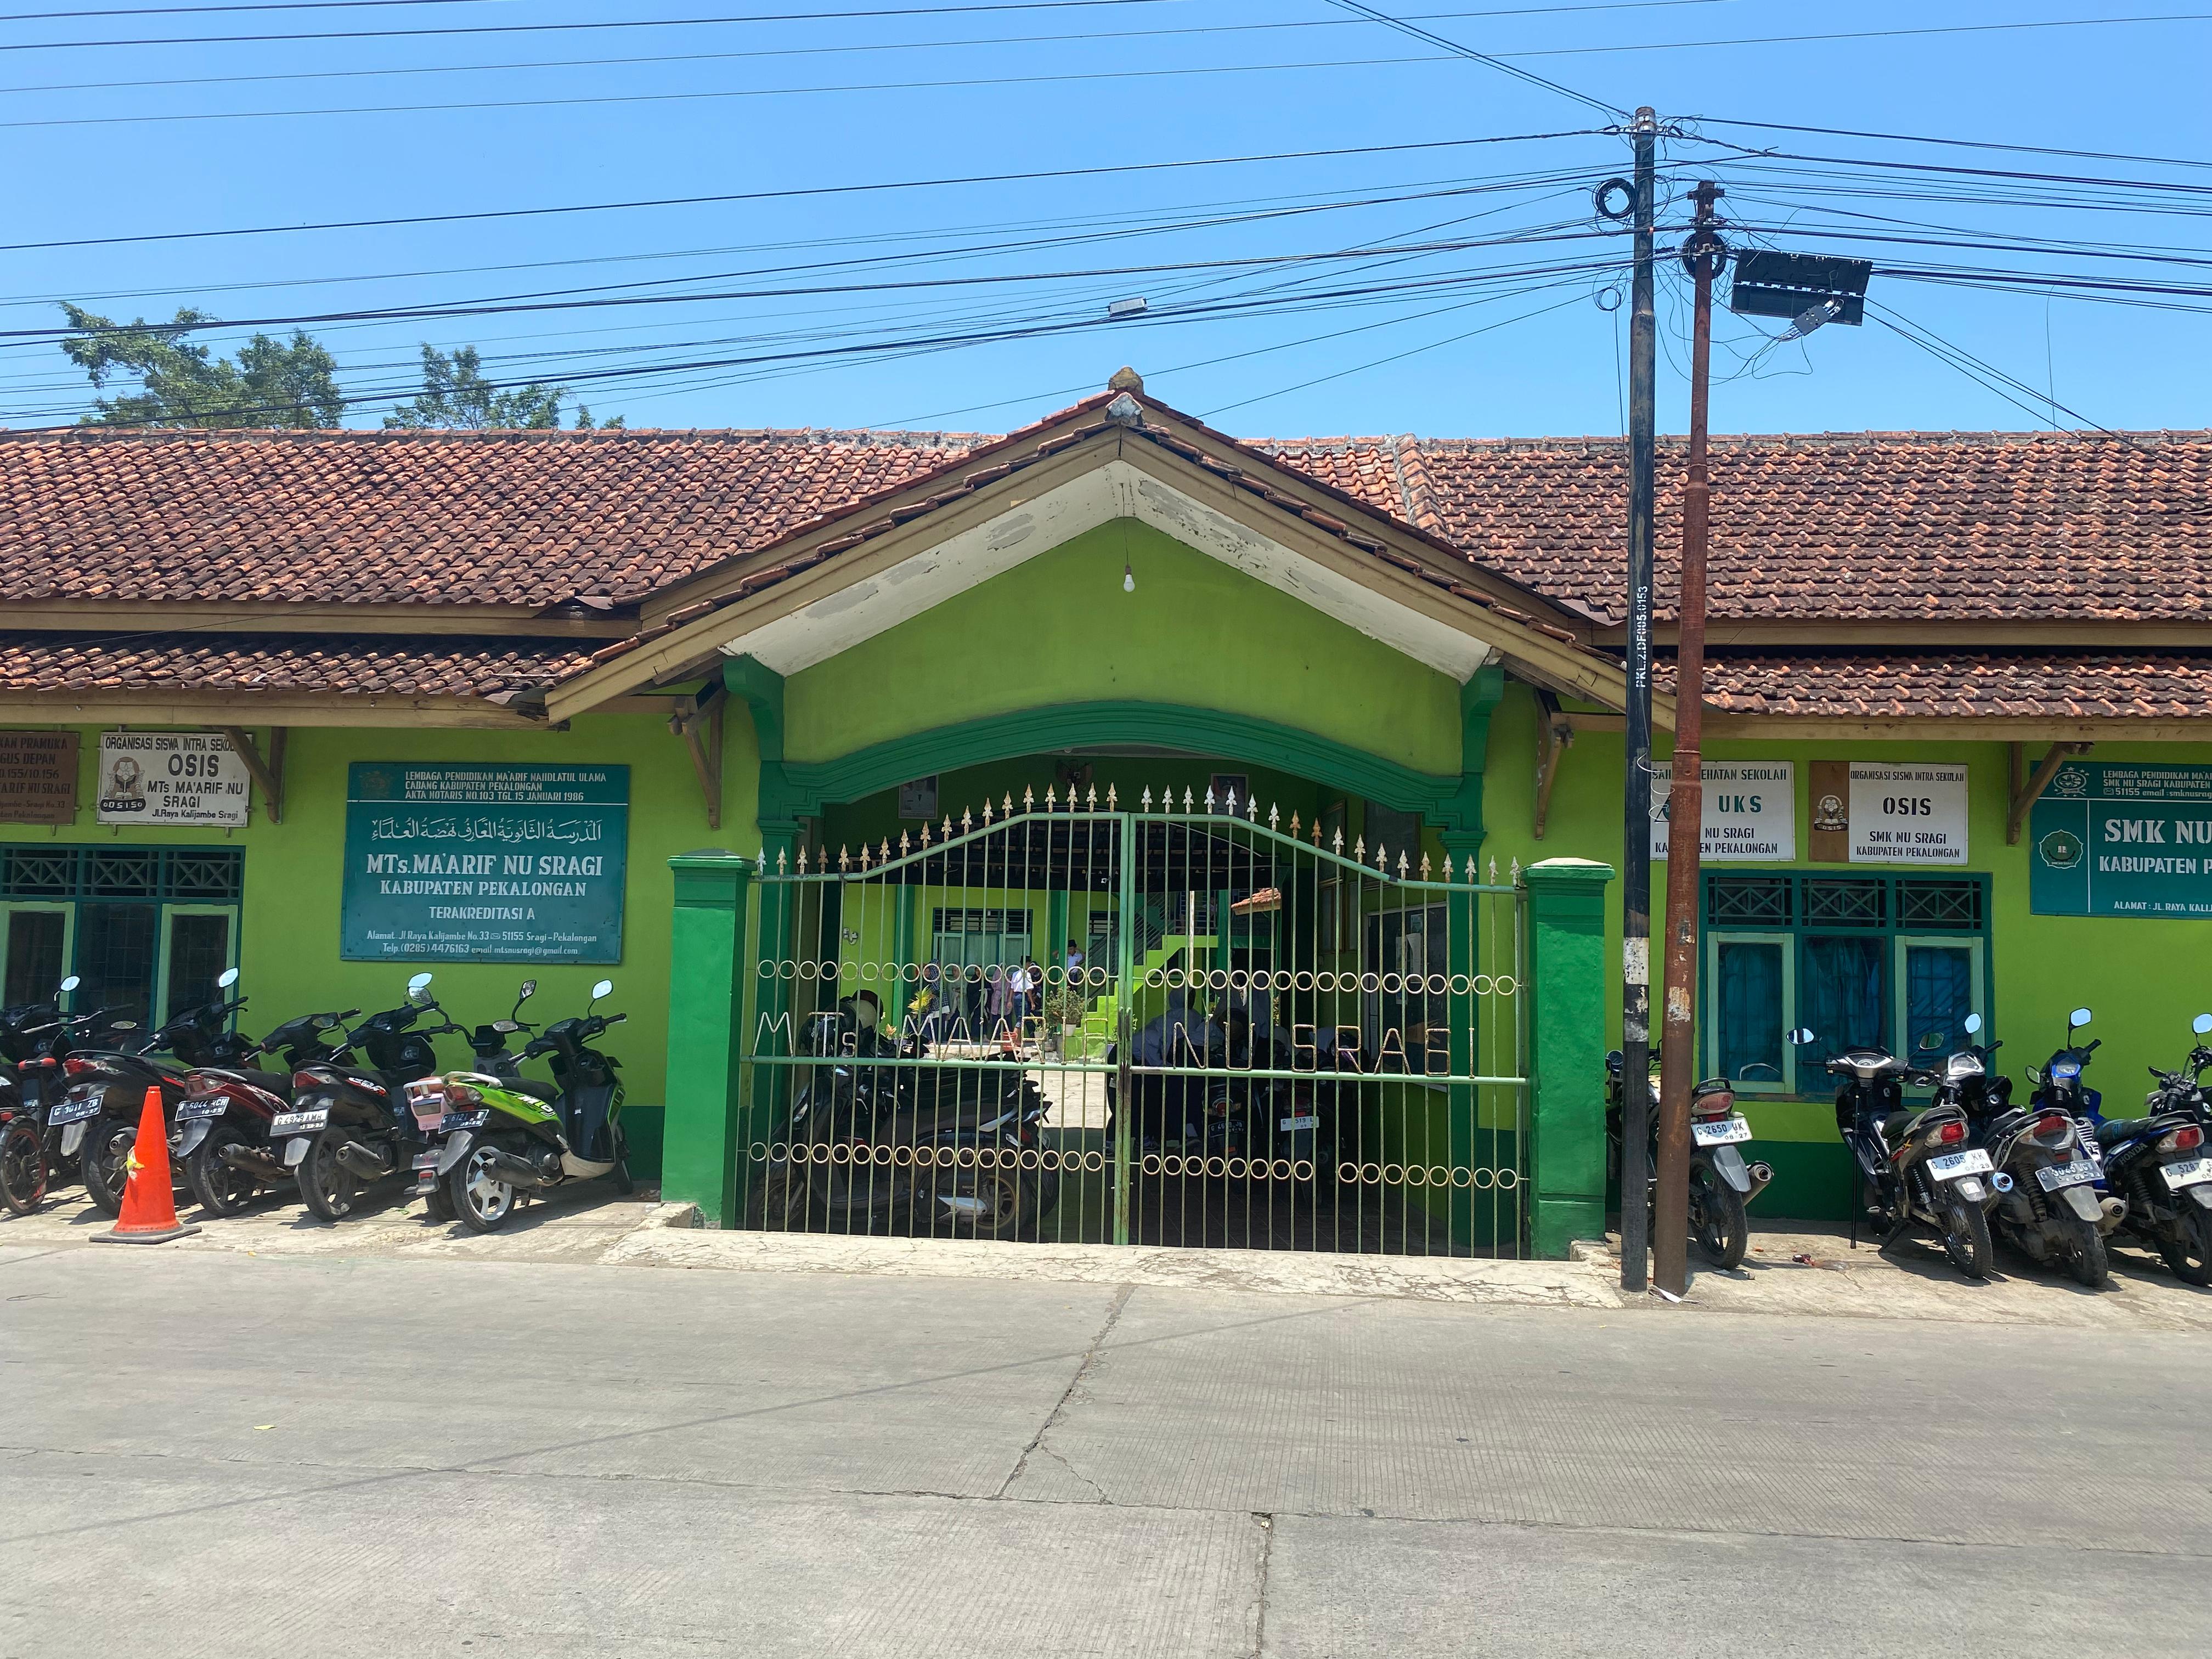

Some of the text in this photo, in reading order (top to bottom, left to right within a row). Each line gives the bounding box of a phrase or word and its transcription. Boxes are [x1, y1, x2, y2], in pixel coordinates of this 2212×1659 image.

[20, 738, 67, 749] PRAMUKA
[105, 737, 153, 750] ORGANISASI
[156, 738, 179, 751] SISWA
[183, 738, 206, 751] INTRA
[23, 753, 55, 765] DEPAN
[168, 754, 219, 777] OSIS
[405, 771, 442, 780] LEMBAGA
[445, 772, 493, 781] PENDIDIKAN
[496, 771, 528, 781] MA'ARIF
[579, 772, 606, 782] ULAMA
[1701, 769, 1737, 780] EHATAN
[1741, 769, 1786, 780] SEKOLAH
[1850, 770, 1964, 782] ORGANISASI SISWA INTRA SEKOLAH
[2103, 770, 2138, 778] LEMBAGA
[2141, 771, 2188, 780] PENDIDIKAN
[28, 783, 40, 793] NU
[42, 783, 70, 794] SRAGI
[147, 781, 243, 795] MTs MA'ARIF NU
[405, 781, 542, 791] CABANG KABUPATEN PEKALONGAN
[2123, 779, 2134, 787] NU
[2137, 780, 2160, 788] SRAGI
[2164, 780, 2210, 788] KABUPATEN
[163, 795, 200, 808] SRAGI
[405, 791, 426, 799] AKTA
[430, 791, 463, 799] NOTARIS
[527, 792, 561, 801] JANUARI
[564, 792, 584, 801] 1986
[1718, 795, 1762, 812] UKS
[1883, 797, 1931, 816] OSIS
[181, 809, 216, 820] Kalijambe
[218, 810, 238, 820] Sragi
[1706, 828, 1754, 838] NU SRAGI
[1870, 831, 1946, 844] SMK NU SRAGI
[2104, 819, 2212, 844] SMK NU
[1716, 843, 1778, 854] PEKALONGAN
[1857, 846, 1960, 858] KABUPATEN PEKALONGAN
[503, 855, 533, 875] NU
[539, 856, 603, 876] SRAGI
[2100, 855, 2197, 874] KABUPATEN
[380, 880, 586, 896] KABUPATEN PEKALONGAN
[428, 906, 535, 920] TERAKREDITASI A
[428, 931, 466, 942] Kalijambe
[503, 932, 523, 940] 51155
[752, 1011, 856, 1058] MTs
[1173, 1021, 1255, 1071] NU
[1706, 1124, 1728, 1134] 2650
[2119, 1142, 2148, 1165] HONDA
